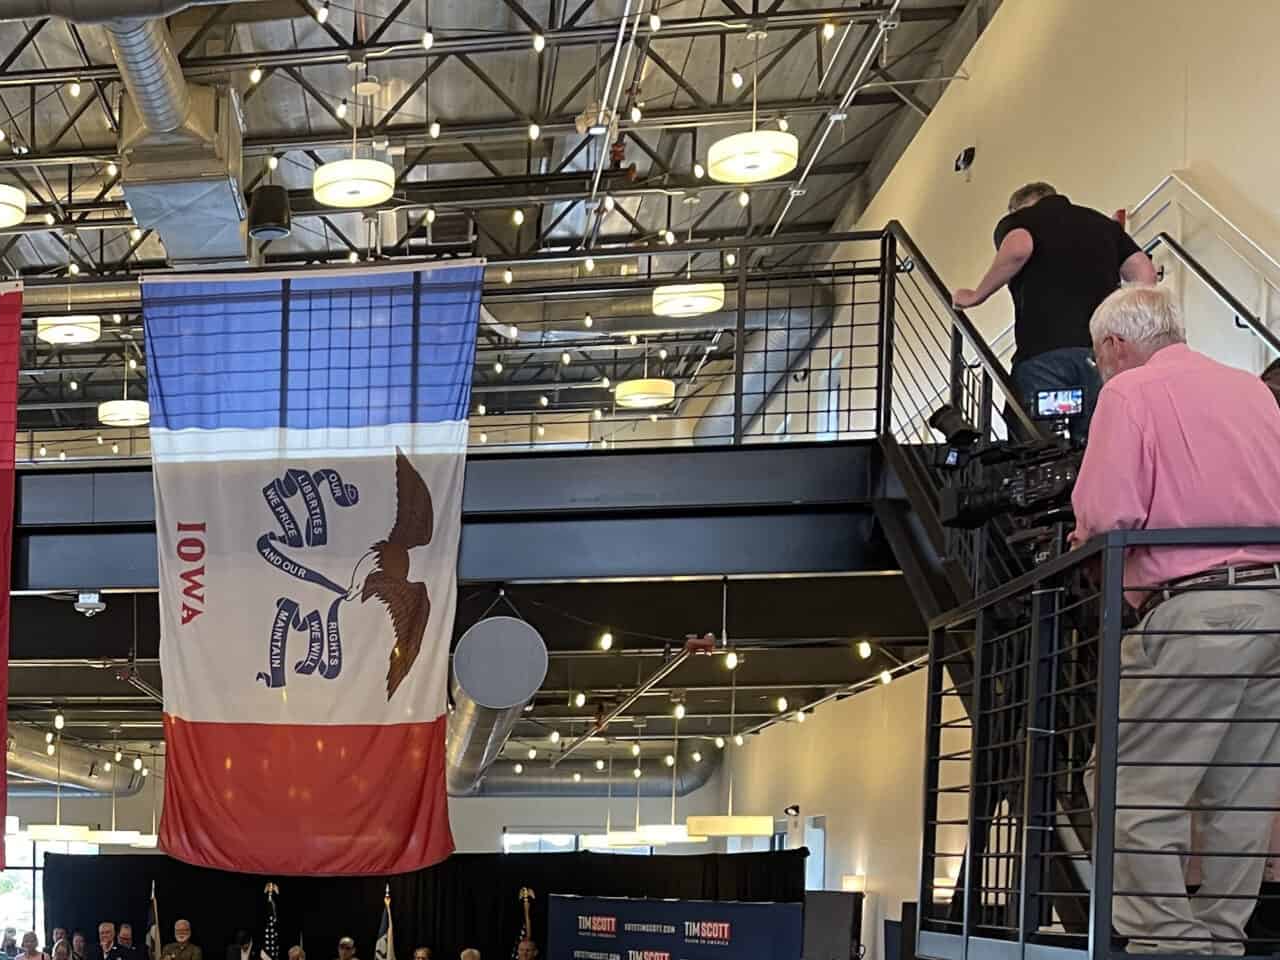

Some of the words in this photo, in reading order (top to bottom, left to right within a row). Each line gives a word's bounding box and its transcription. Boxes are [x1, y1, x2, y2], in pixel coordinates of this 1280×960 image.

[328, 474, 342, 497] OUR
[265, 487, 281, 507] WE
[275, 505, 298, 538] PRIZE
[298, 475, 323, 535] LIBERTIES
[177, 521, 207, 625] IOWA
[262, 548, 282, 567] AND
[282, 561, 307, 578] OUR
[271, 609, 289, 668] MAINTAIN
[310, 620, 322, 639] WE
[328, 621, 340, 666] RIGHTS
[304, 642, 322, 668] WILL
[578, 915, 592, 930] TIM
[592, 916, 617, 933] SCOTT
[684, 921, 700, 937] TIM
[701, 922, 731, 939] SCOTT
